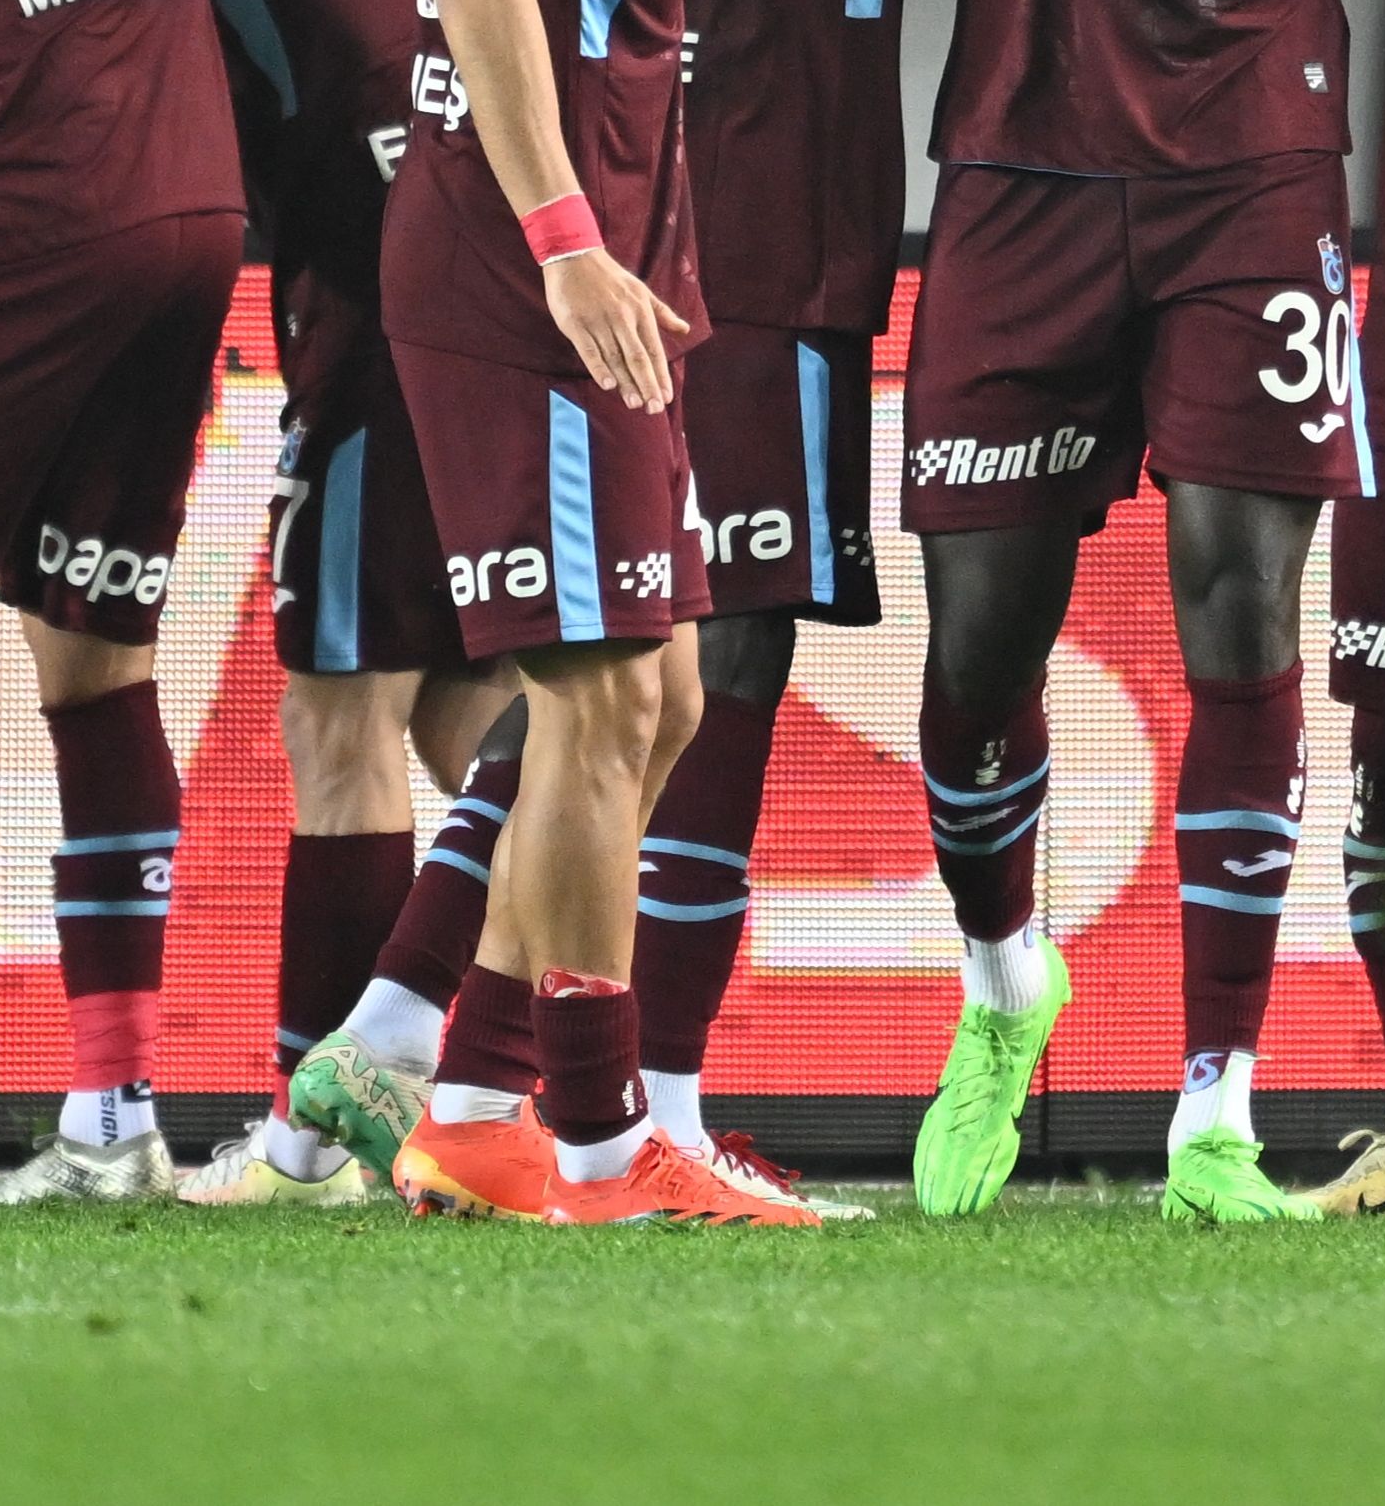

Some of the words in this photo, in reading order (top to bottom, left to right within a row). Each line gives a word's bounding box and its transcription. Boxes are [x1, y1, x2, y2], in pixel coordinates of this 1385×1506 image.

[1258, 291, 1351, 406] 30
[945, 434, 1045, 486] Rent
[1047, 426, 1097, 475] Go
